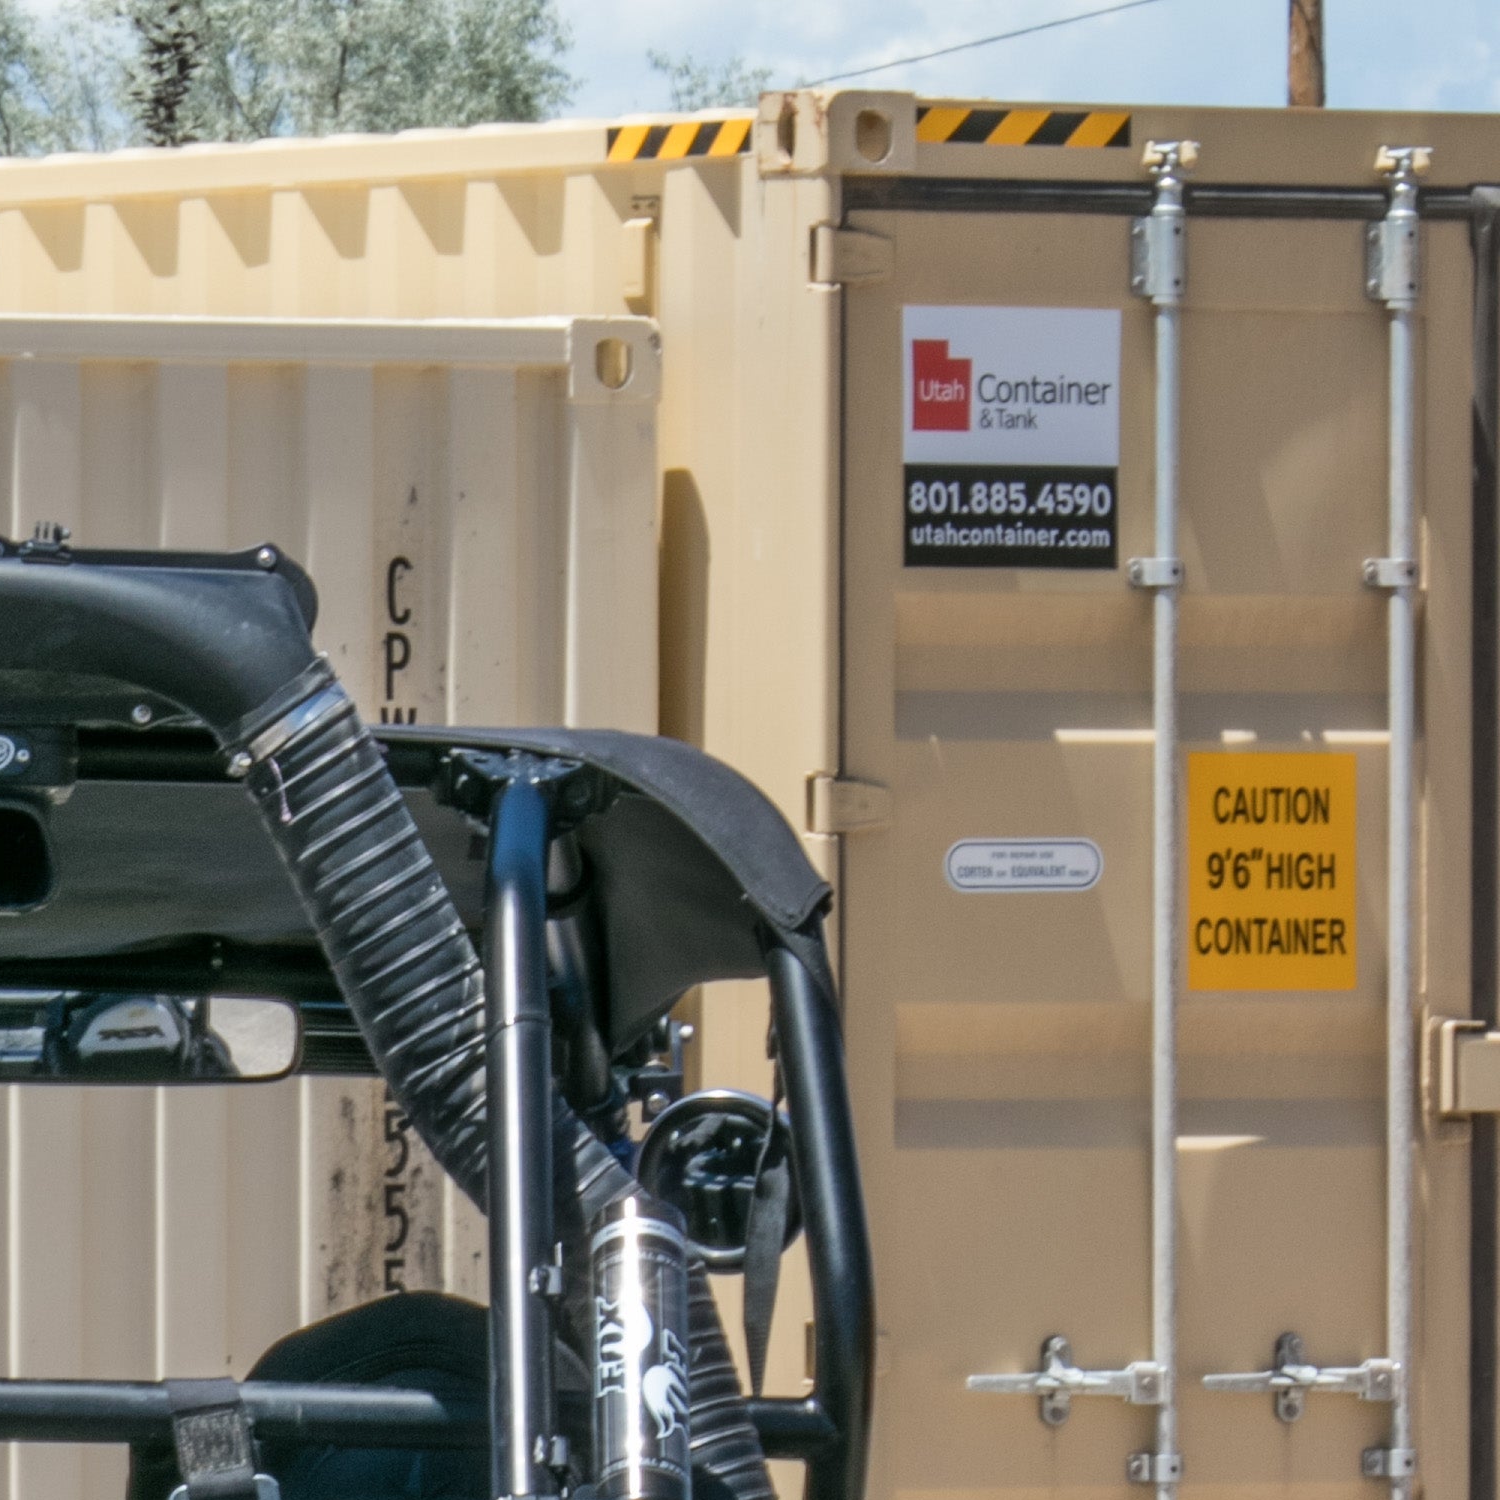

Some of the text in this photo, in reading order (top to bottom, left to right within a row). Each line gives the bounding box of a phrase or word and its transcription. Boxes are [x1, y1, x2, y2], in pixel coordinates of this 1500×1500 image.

[919, 373, 1111, 405] Utah Container
[909, 481, 1111, 515] 801.885.4590
[911, 522, 1111, 547] utahcontainer.com
[1213, 787, 1331, 825] CAUTION
[1195, 917, 1347, 955] CONTAINER
